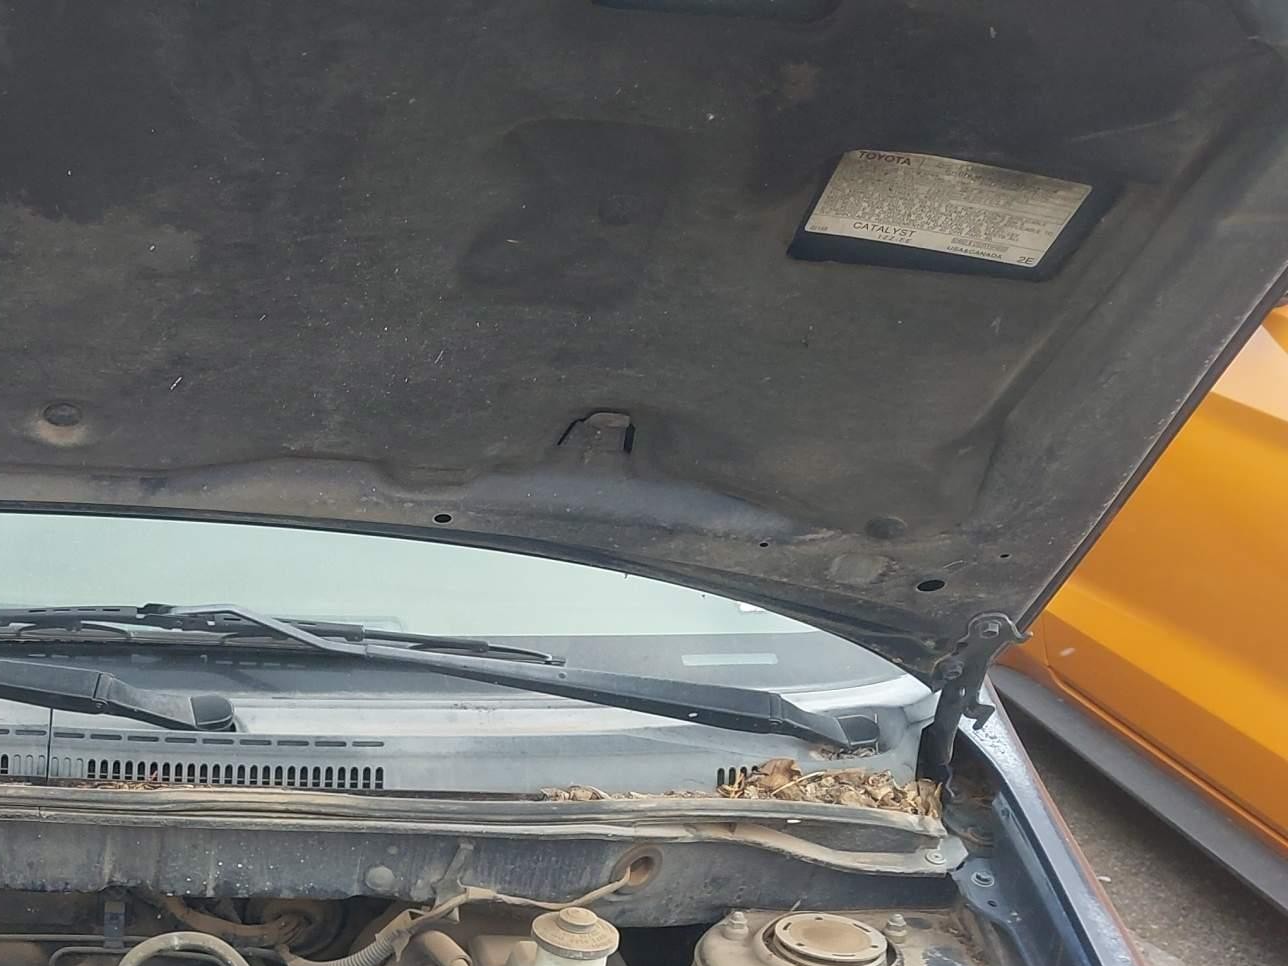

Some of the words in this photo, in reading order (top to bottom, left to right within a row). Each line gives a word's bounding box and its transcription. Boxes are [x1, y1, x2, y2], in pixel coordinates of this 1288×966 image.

[858, 150, 912, 166] TOYOTA
[852, 221, 916, 239] CATALYST
[1016, 255, 1035, 266] 2E
